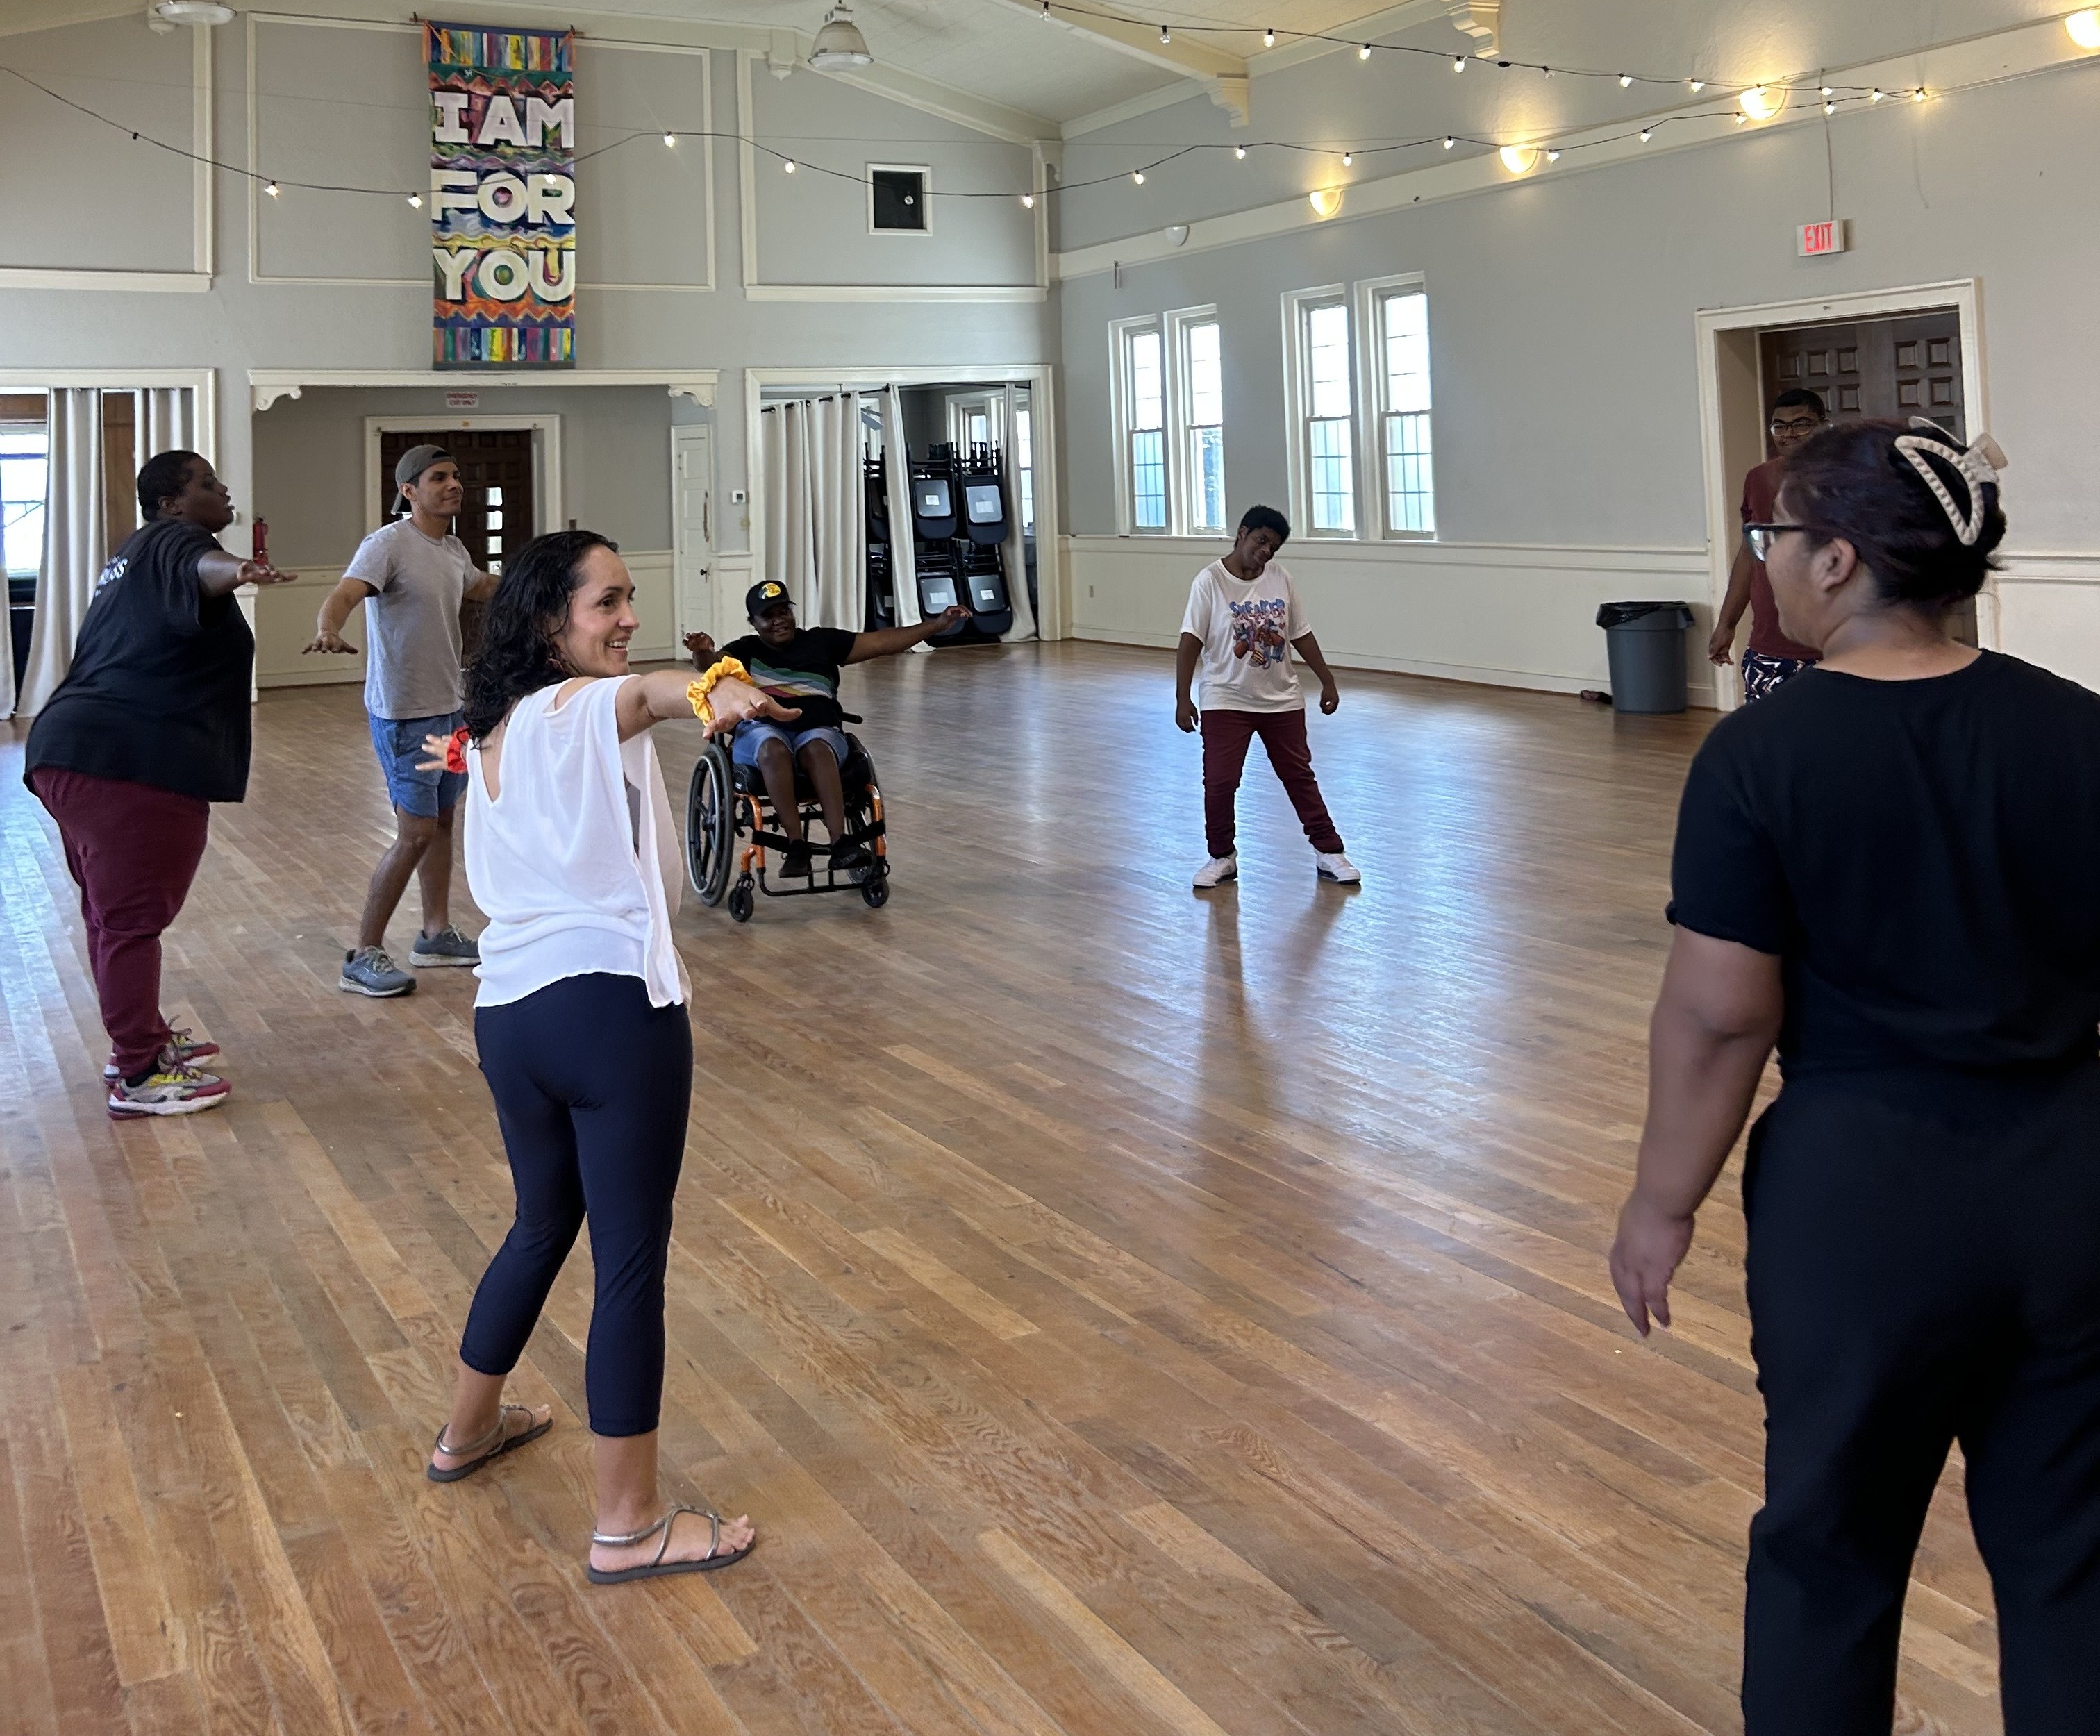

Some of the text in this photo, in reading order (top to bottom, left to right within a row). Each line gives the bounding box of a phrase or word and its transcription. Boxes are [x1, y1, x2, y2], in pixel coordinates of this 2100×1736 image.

[434, 92, 574, 148] I AM
[431, 169, 575, 224] FOR
[1804, 222, 1833, 253] EXIT
[433, 249, 575, 301] YOU
